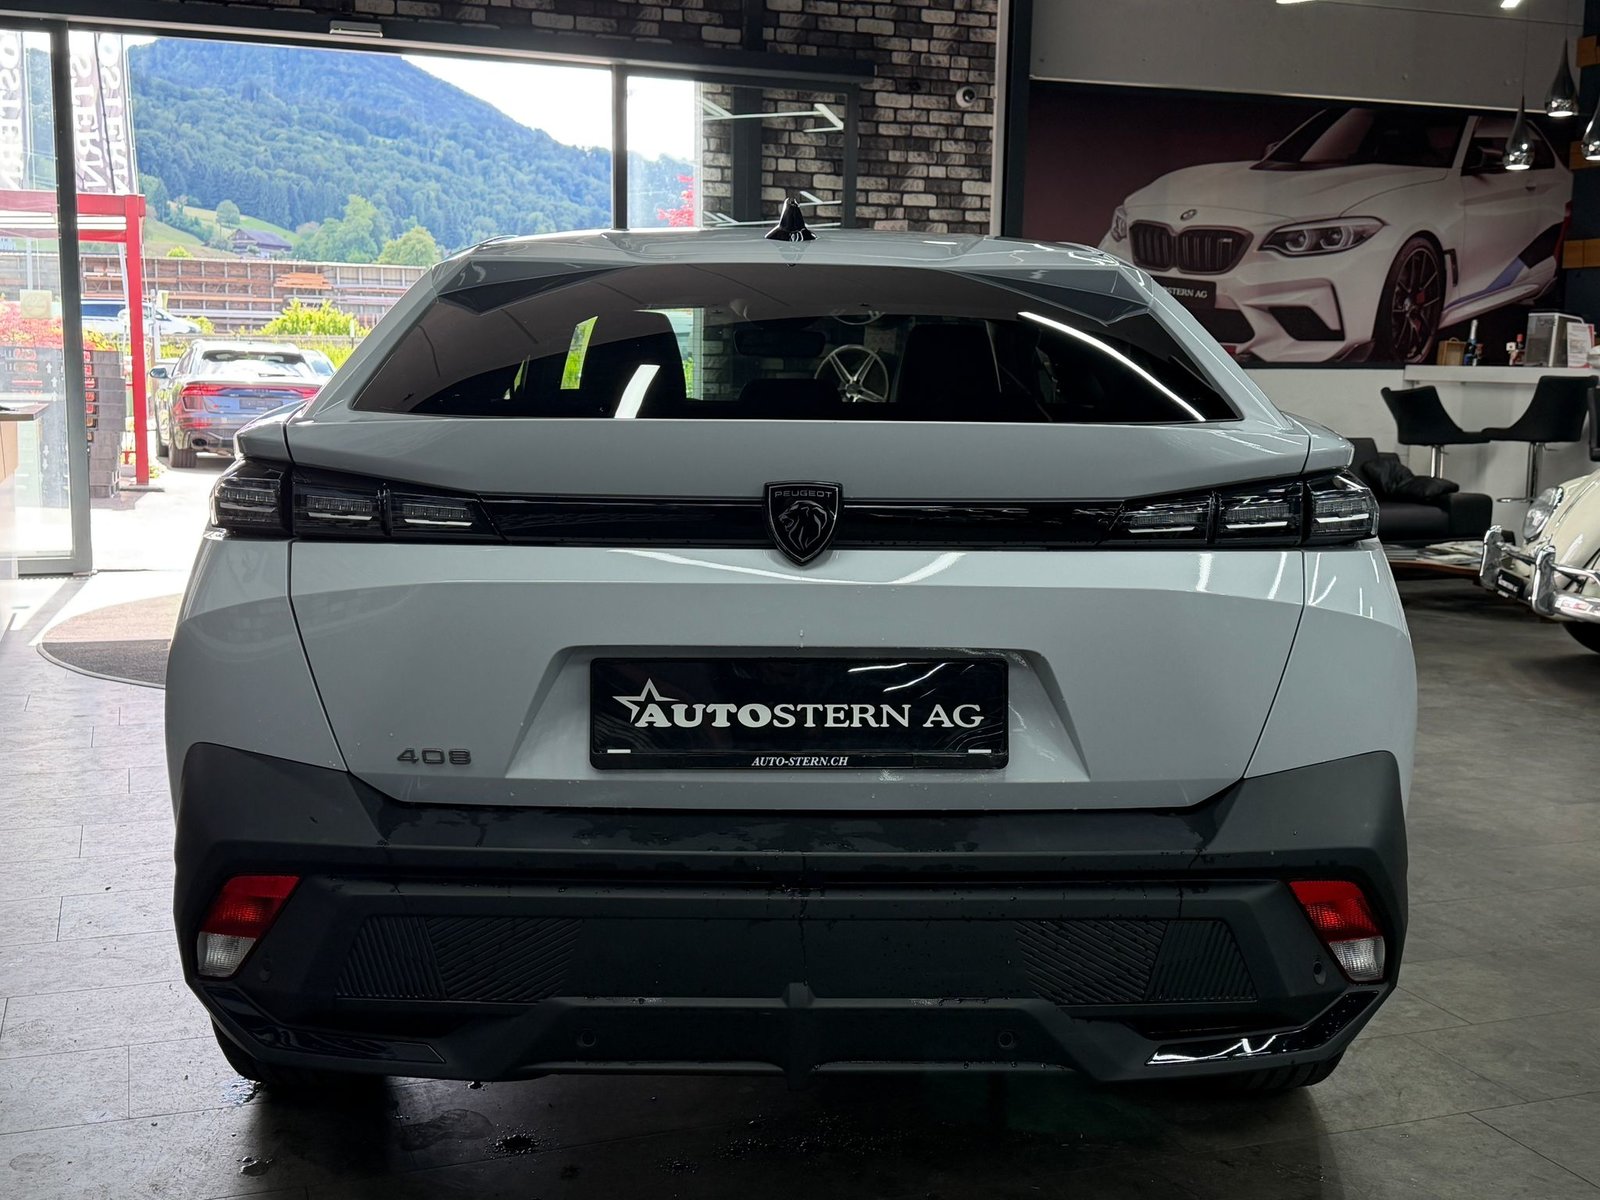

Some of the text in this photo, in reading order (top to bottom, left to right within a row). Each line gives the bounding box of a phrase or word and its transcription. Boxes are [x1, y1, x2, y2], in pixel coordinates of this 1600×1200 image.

[1166, 286, 1208, 299] STERN AG
[775, 490, 833, 498] PEUGEOT
[634, 702, 985, 728] AUTOSTERN AG
[396, 747, 472, 765] 408
[752, 755, 849, 767] AUTO-STERN.CH
